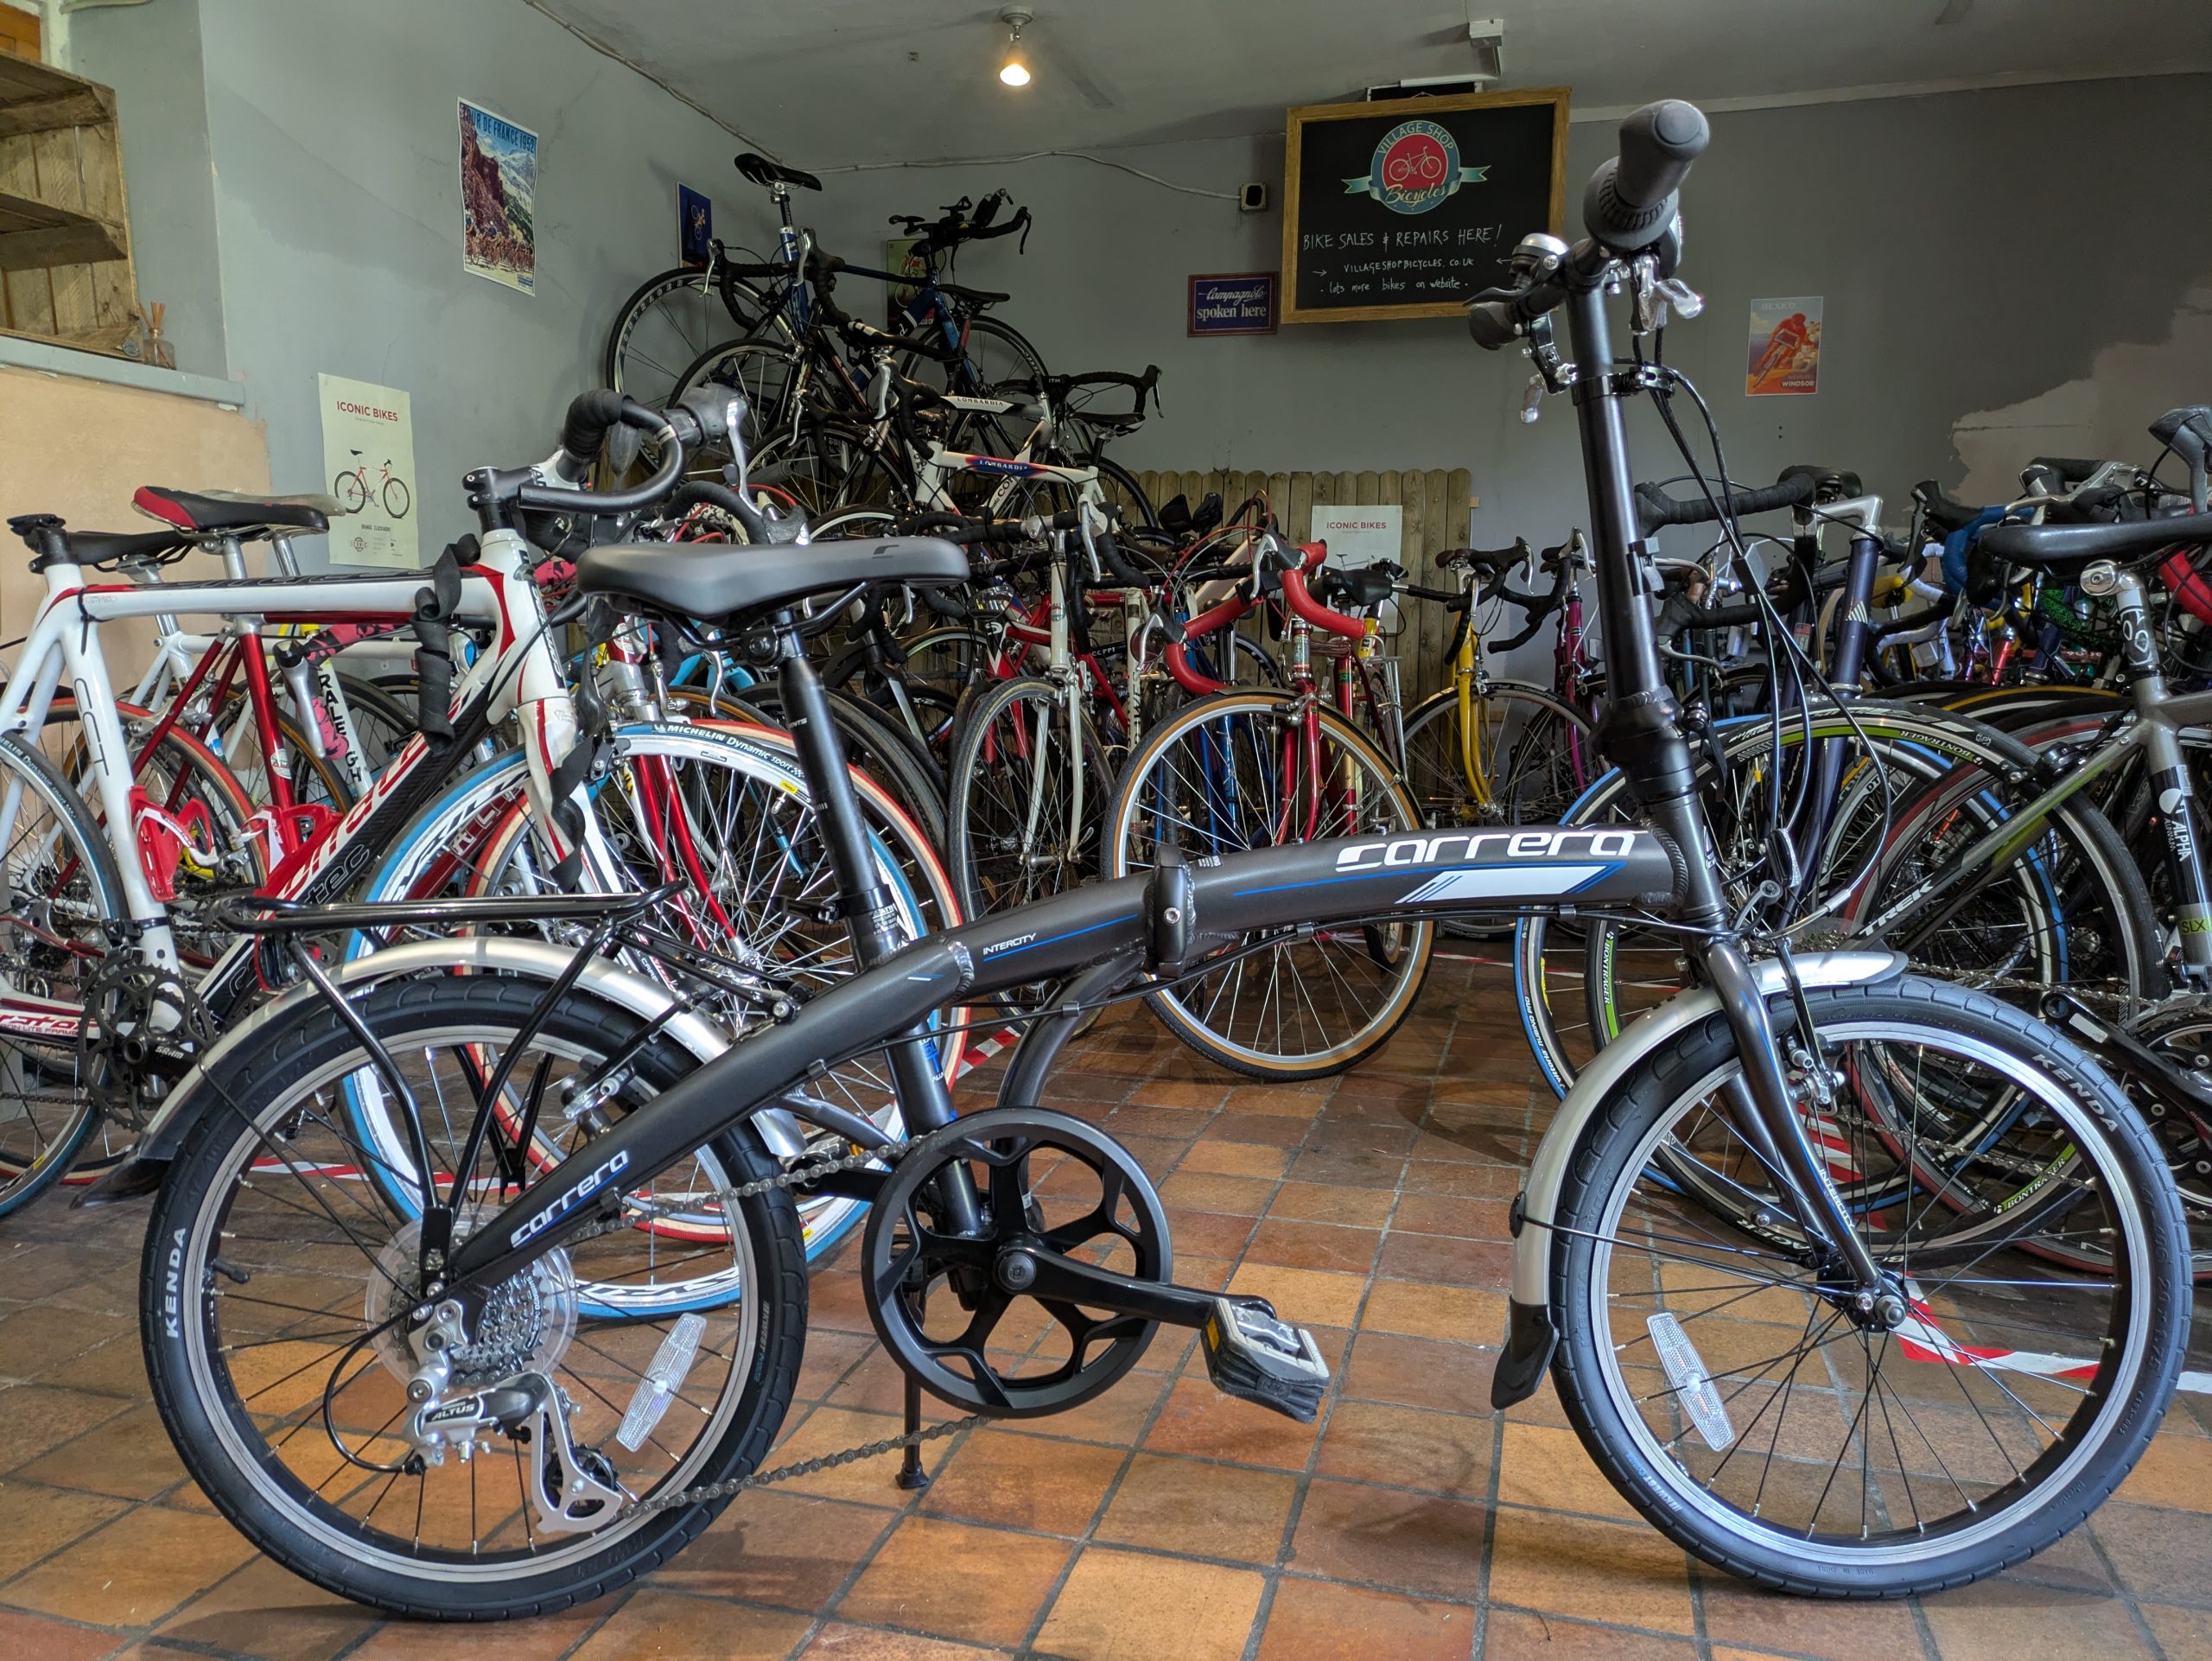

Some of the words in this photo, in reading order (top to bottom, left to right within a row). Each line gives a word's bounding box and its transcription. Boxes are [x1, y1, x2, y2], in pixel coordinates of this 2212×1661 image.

[483, 118, 493, 134] DE
[493, 122, 518, 146] FRANCE
[519, 134, 535, 154] 1952
[1377, 122, 1423, 156] VILLAGE
[1426, 123, 1454, 150] SHOP
[1384, 182, 1447, 207] Bicycles
[1302, 234, 1333, 250] BIKE
[1338, 232, 1375, 250] SALES
[1395, 228, 1449, 248] REPAIRS
[1205, 285, 1267, 306] Campagnolo
[1329, 281, 1345, 294] lots
[1351, 283, 1370, 292] more
[1381, 277, 1406, 290] bikes
[1429, 276, 1461, 290] website
[1197, 303, 1236, 321] spoken
[1241, 303, 1267, 317] here
[336, 400, 372, 417] ICONIC
[372, 408, 398, 423] BIKES
[957, 396, 1004, 407] LOMBARDIA
[319, 672, 362, 783] RALEGH
[667, 724, 726, 741] MICHELIN
[727, 736, 772, 760] Dynamic
[771, 755, 792, 771] sport
[1900, 730, 1972, 757] BONTRAGER
[1335, 831, 1637, 873] carrera
[2171, 820, 2191, 863] ALPHA
[1859, 879, 1935, 937] TREK
[2180, 920, 2206, 934] SLX
[982, 932, 1038, 956] INTERCITY
[1603, 941, 1611, 1005] BONTRAGER
[1524, 996, 1534, 1014] PRO
[155, 1046, 184, 1059] SRAM
[2031, 1053, 2119, 1132] KENDA
[1820, 1168, 1855, 1228] INTERCITY
[2007, 1157, 2066, 1209] BONTRAER
[510, 1149, 629, 1249] carrera
[165, 1227, 188, 1340] KENDA
[431, 1403, 475, 1421] ALTUS
